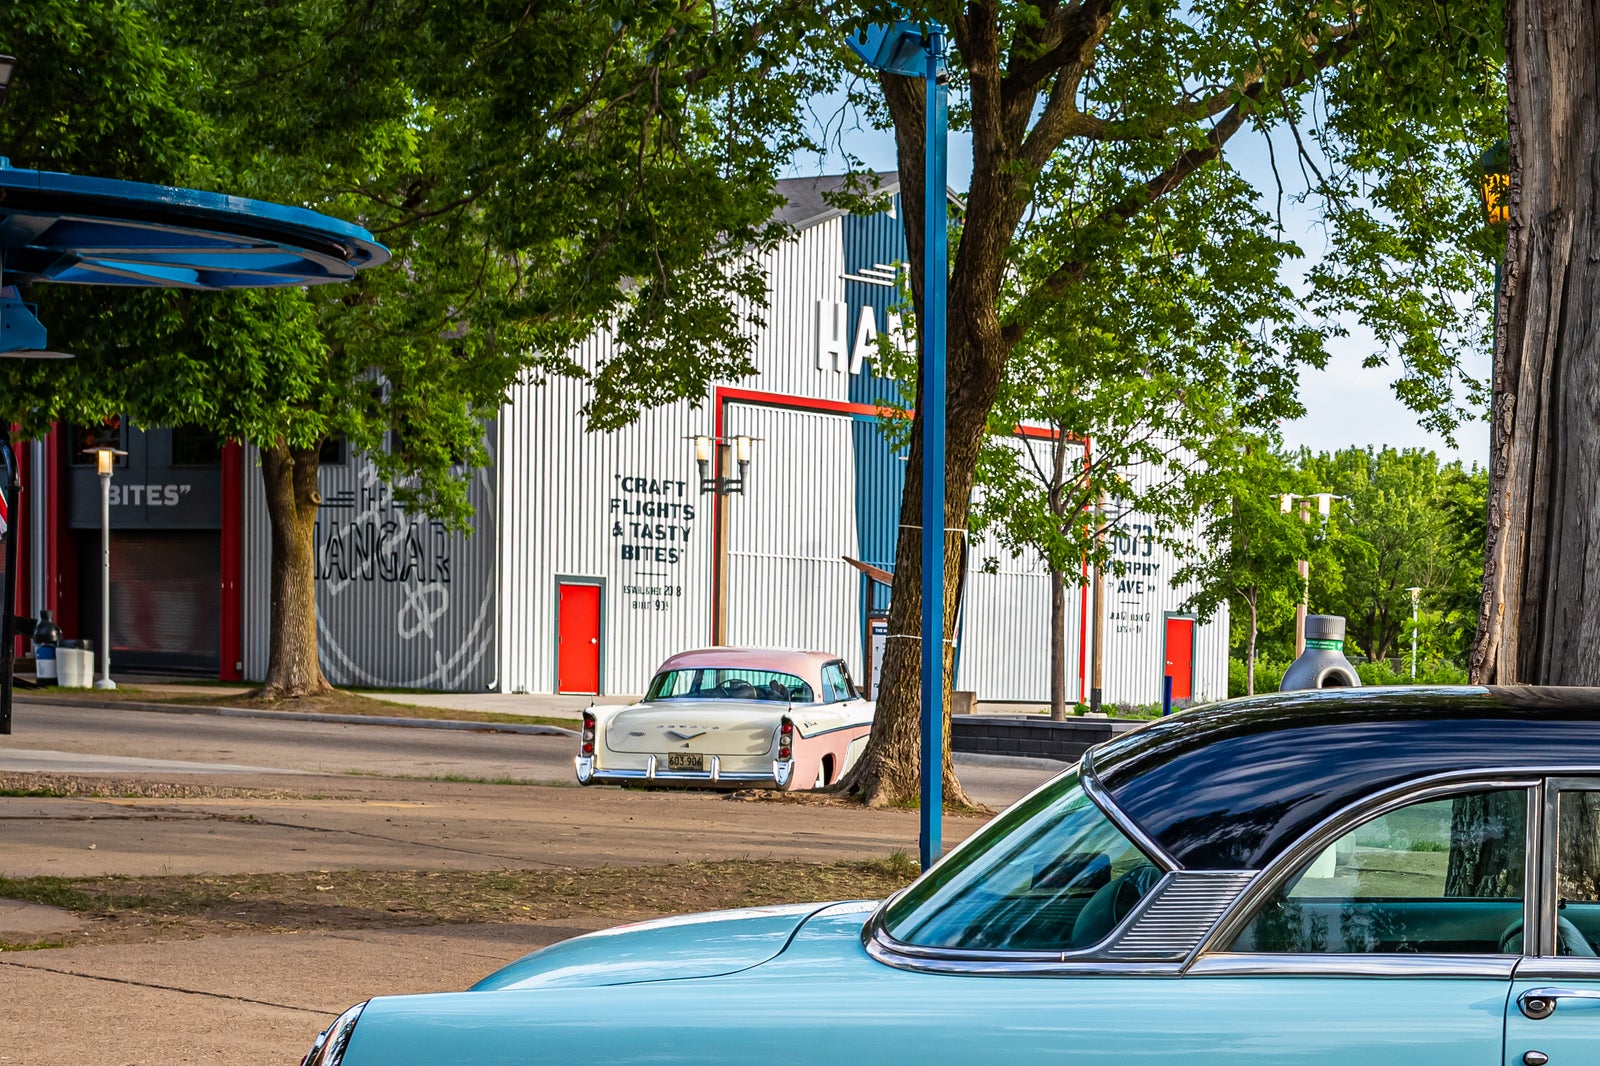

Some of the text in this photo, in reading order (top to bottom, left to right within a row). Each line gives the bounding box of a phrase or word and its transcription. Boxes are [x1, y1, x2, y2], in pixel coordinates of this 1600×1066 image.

[610, 498, 696, 520] FLIGHTS
[612, 521, 691, 542] & TASTY
[314, 522, 450, 582] ANGAR
[1117, 580, 1143, 594] AVE
